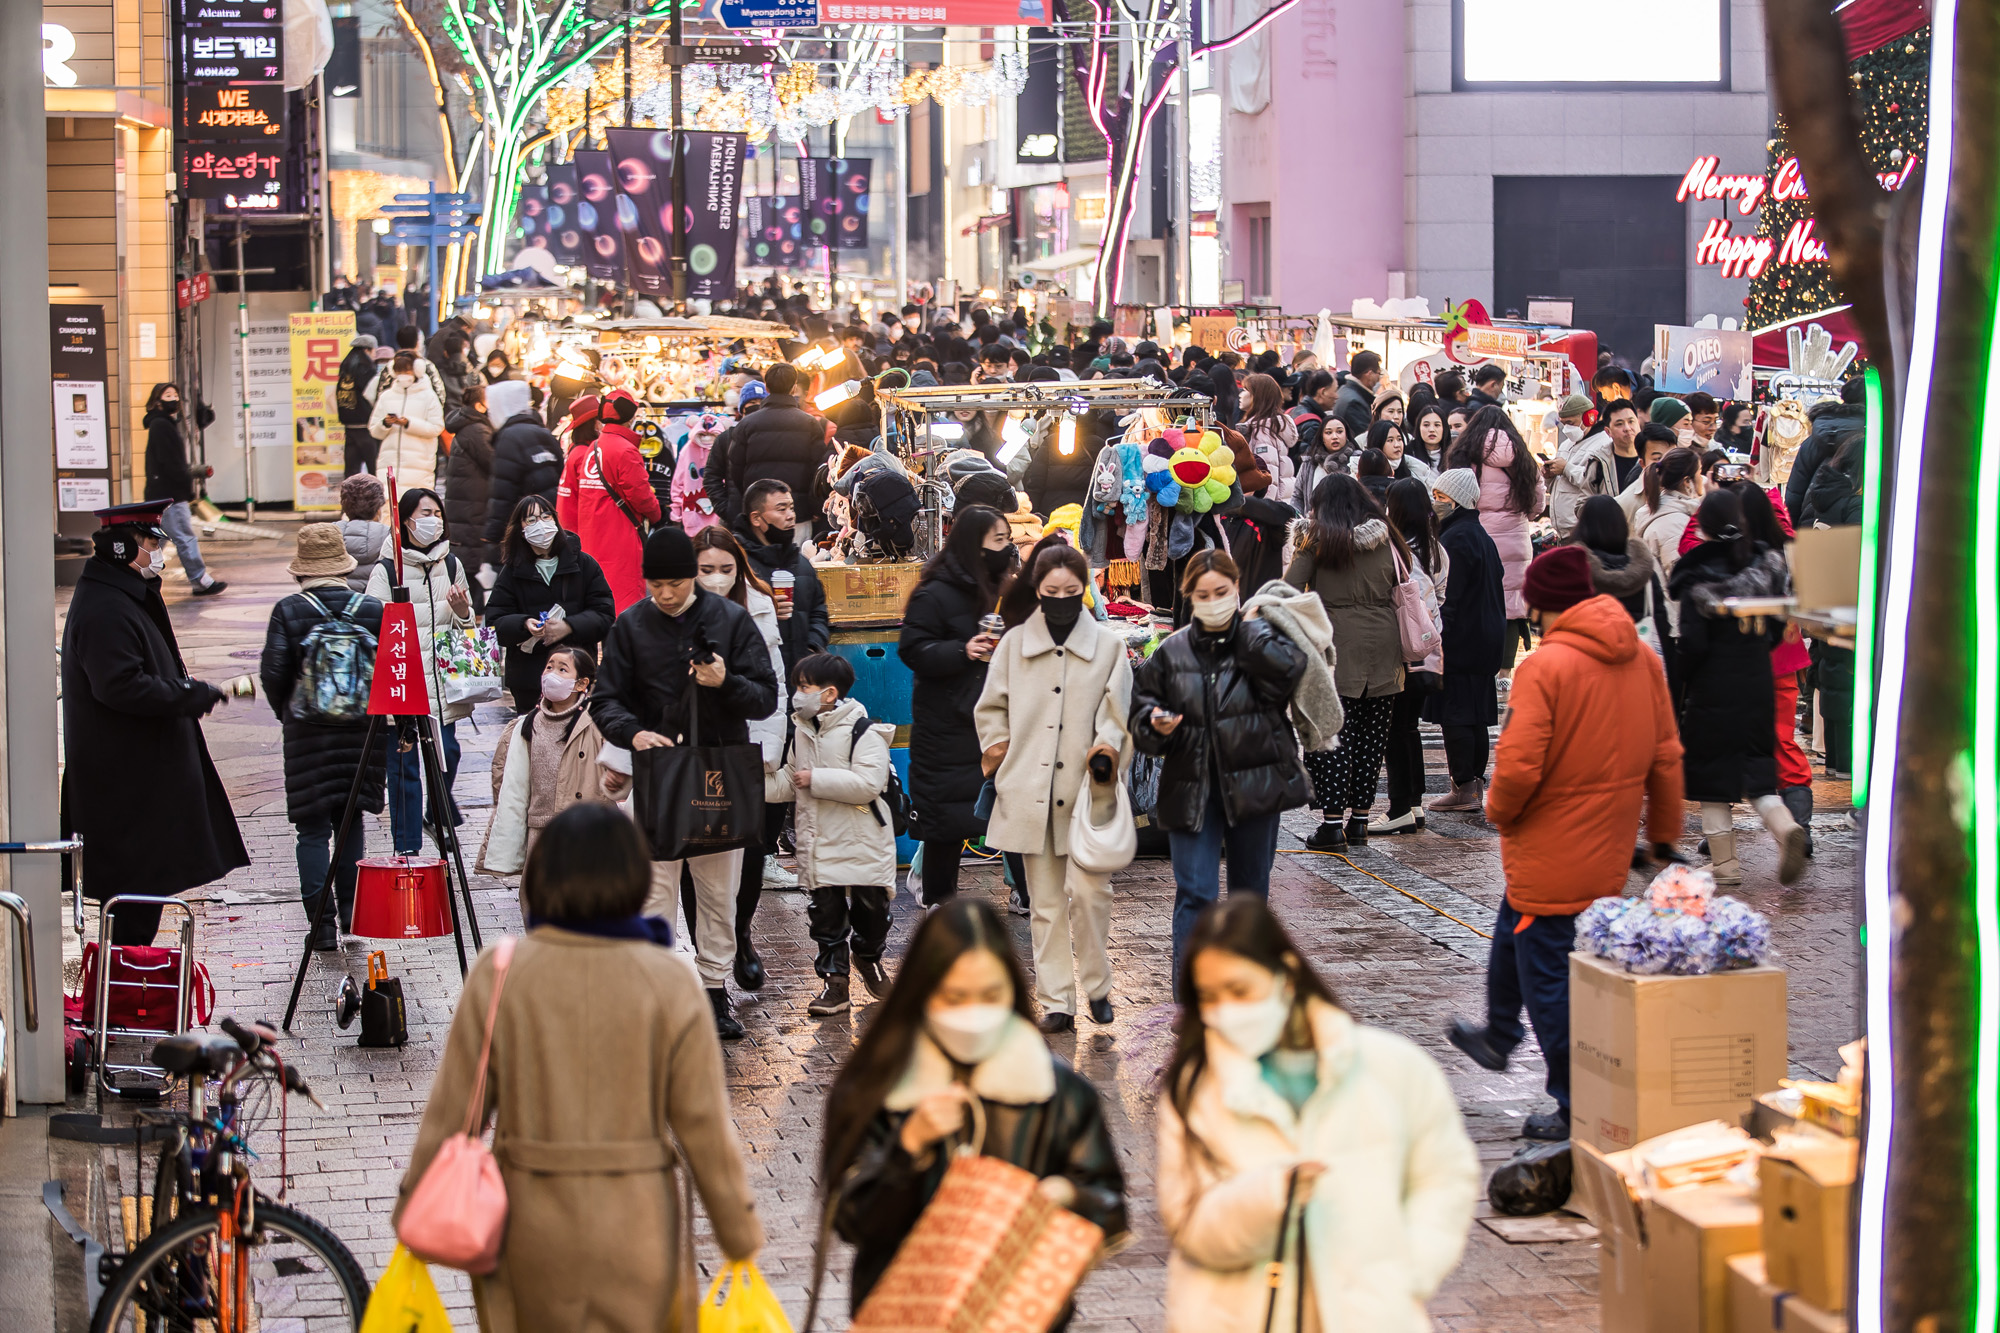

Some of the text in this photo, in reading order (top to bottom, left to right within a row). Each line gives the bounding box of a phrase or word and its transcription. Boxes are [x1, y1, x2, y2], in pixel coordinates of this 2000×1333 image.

[198, 7, 241, 18] Alcatraz
[741, 8, 795, 17] Myeongdong
[796, 8, 816, 17] 8-gil
[192, 36, 277, 59] 보드게임
[264, 66, 278, 77] 7F
[217, 89, 250, 108] WE
[198, 109, 269, 127] 시계거래소
[263, 124, 281, 135] 6F
[190, 151, 281, 179] 약손명가
[1675, 155, 1767, 215] Merry
[1696, 217, 1775, 279] Happy
[315, 315, 355, 326] HELLO
[71, 335, 83, 344] 1st
[292, 328, 310, 336] Foot
[1476, 332, 1500, 350] CHICKEN
[61, 346, 94, 354] Anniversary
[1684, 338, 1721, 376] OREO
[303, 339, 341, 383] 足
[389, 619, 408, 702] 자선냄비
